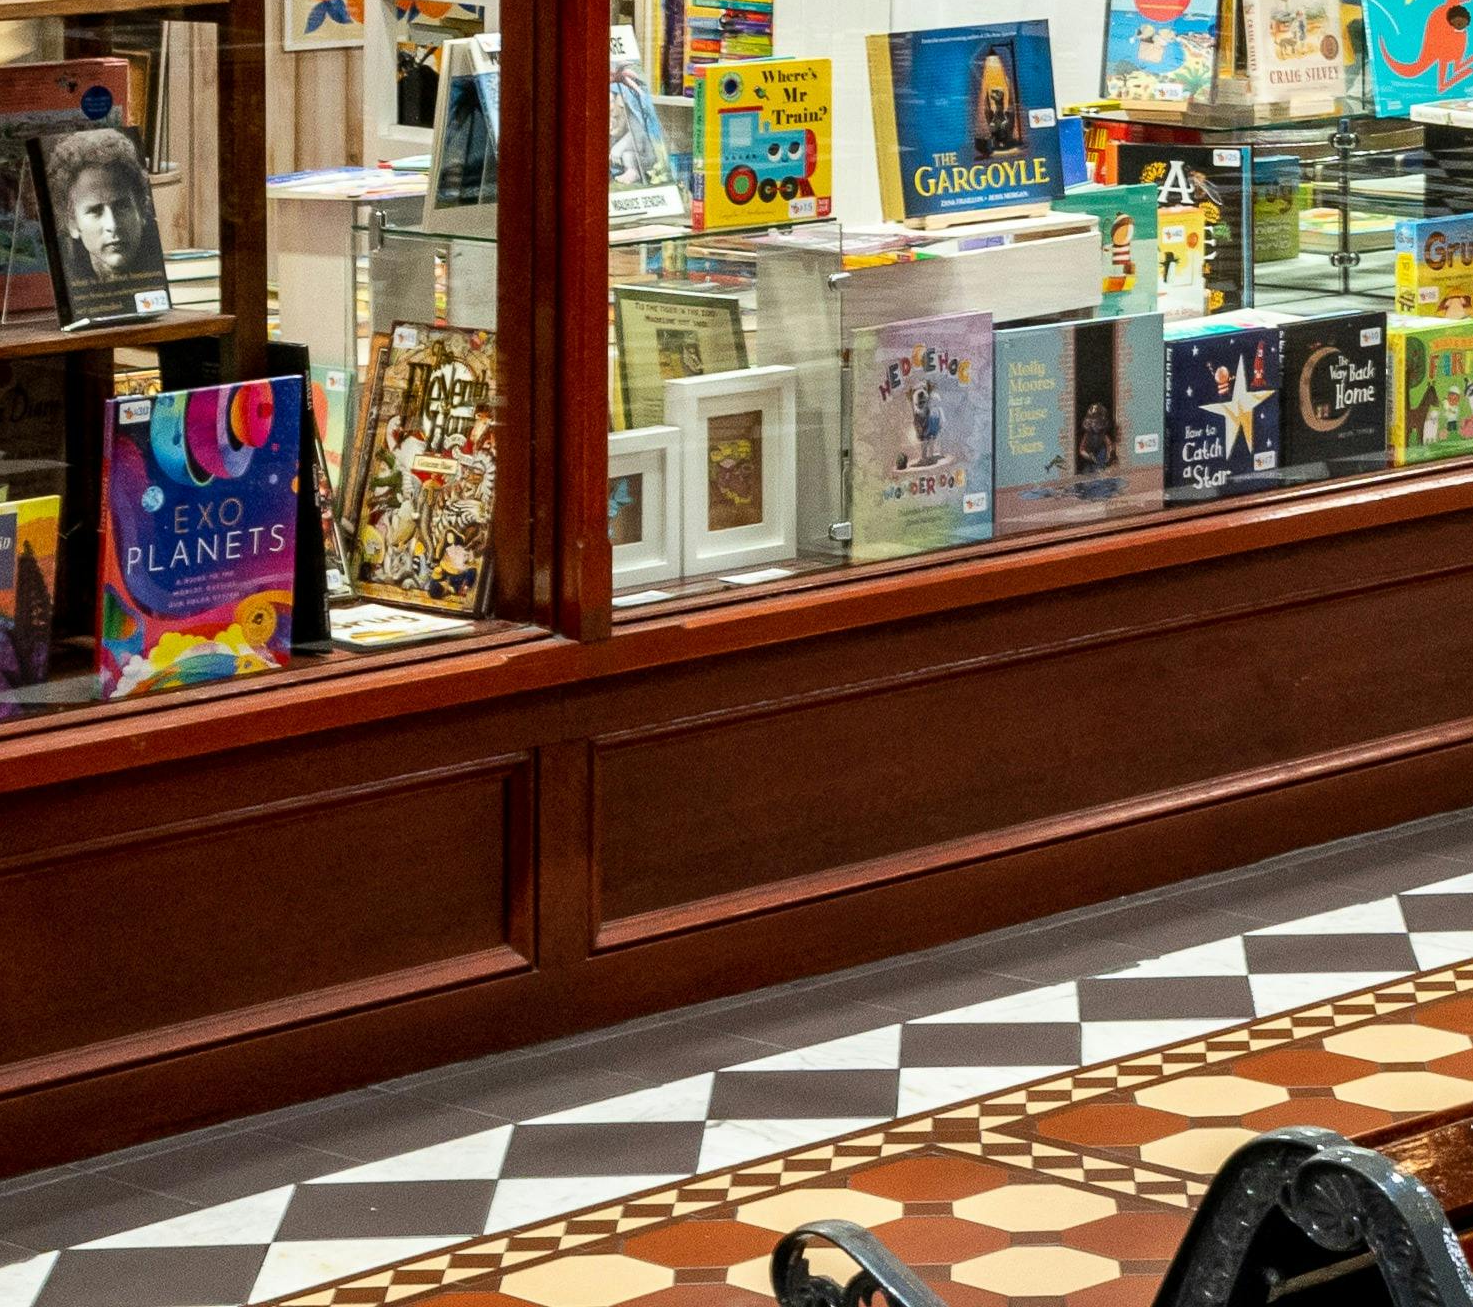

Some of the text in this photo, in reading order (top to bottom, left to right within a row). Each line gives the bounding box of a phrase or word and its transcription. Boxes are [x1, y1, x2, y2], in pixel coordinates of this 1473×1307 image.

[761, 67, 818, 84] Where's
[1268, 65, 1340, 85] CRAIG SILVEY
[782, 86, 808, 103] Mr
[771, 106, 828, 125] Train?
[932, 152, 958, 167] THE
[914, 157, 1050, 197] GARGOYLE
[1157, 160, 1195, 205] A
[1007, 360, 1047, 378] Molly
[1329, 359, 1375, 381] Way Back
[1337, 355, 1350, 368] The
[879, 342, 973, 403] HEDGEHOG
[1334, 384, 1375, 410] Home
[1008, 407, 1049, 423] House
[1008, 424, 1036, 441] Like
[1185, 424, 1216, 440] How to
[1182, 437, 1223, 464] Catch
[1183, 465, 1231, 490] a Star
[174, 497, 244, 536] EXO
[127, 524, 286, 576] PLANETS
